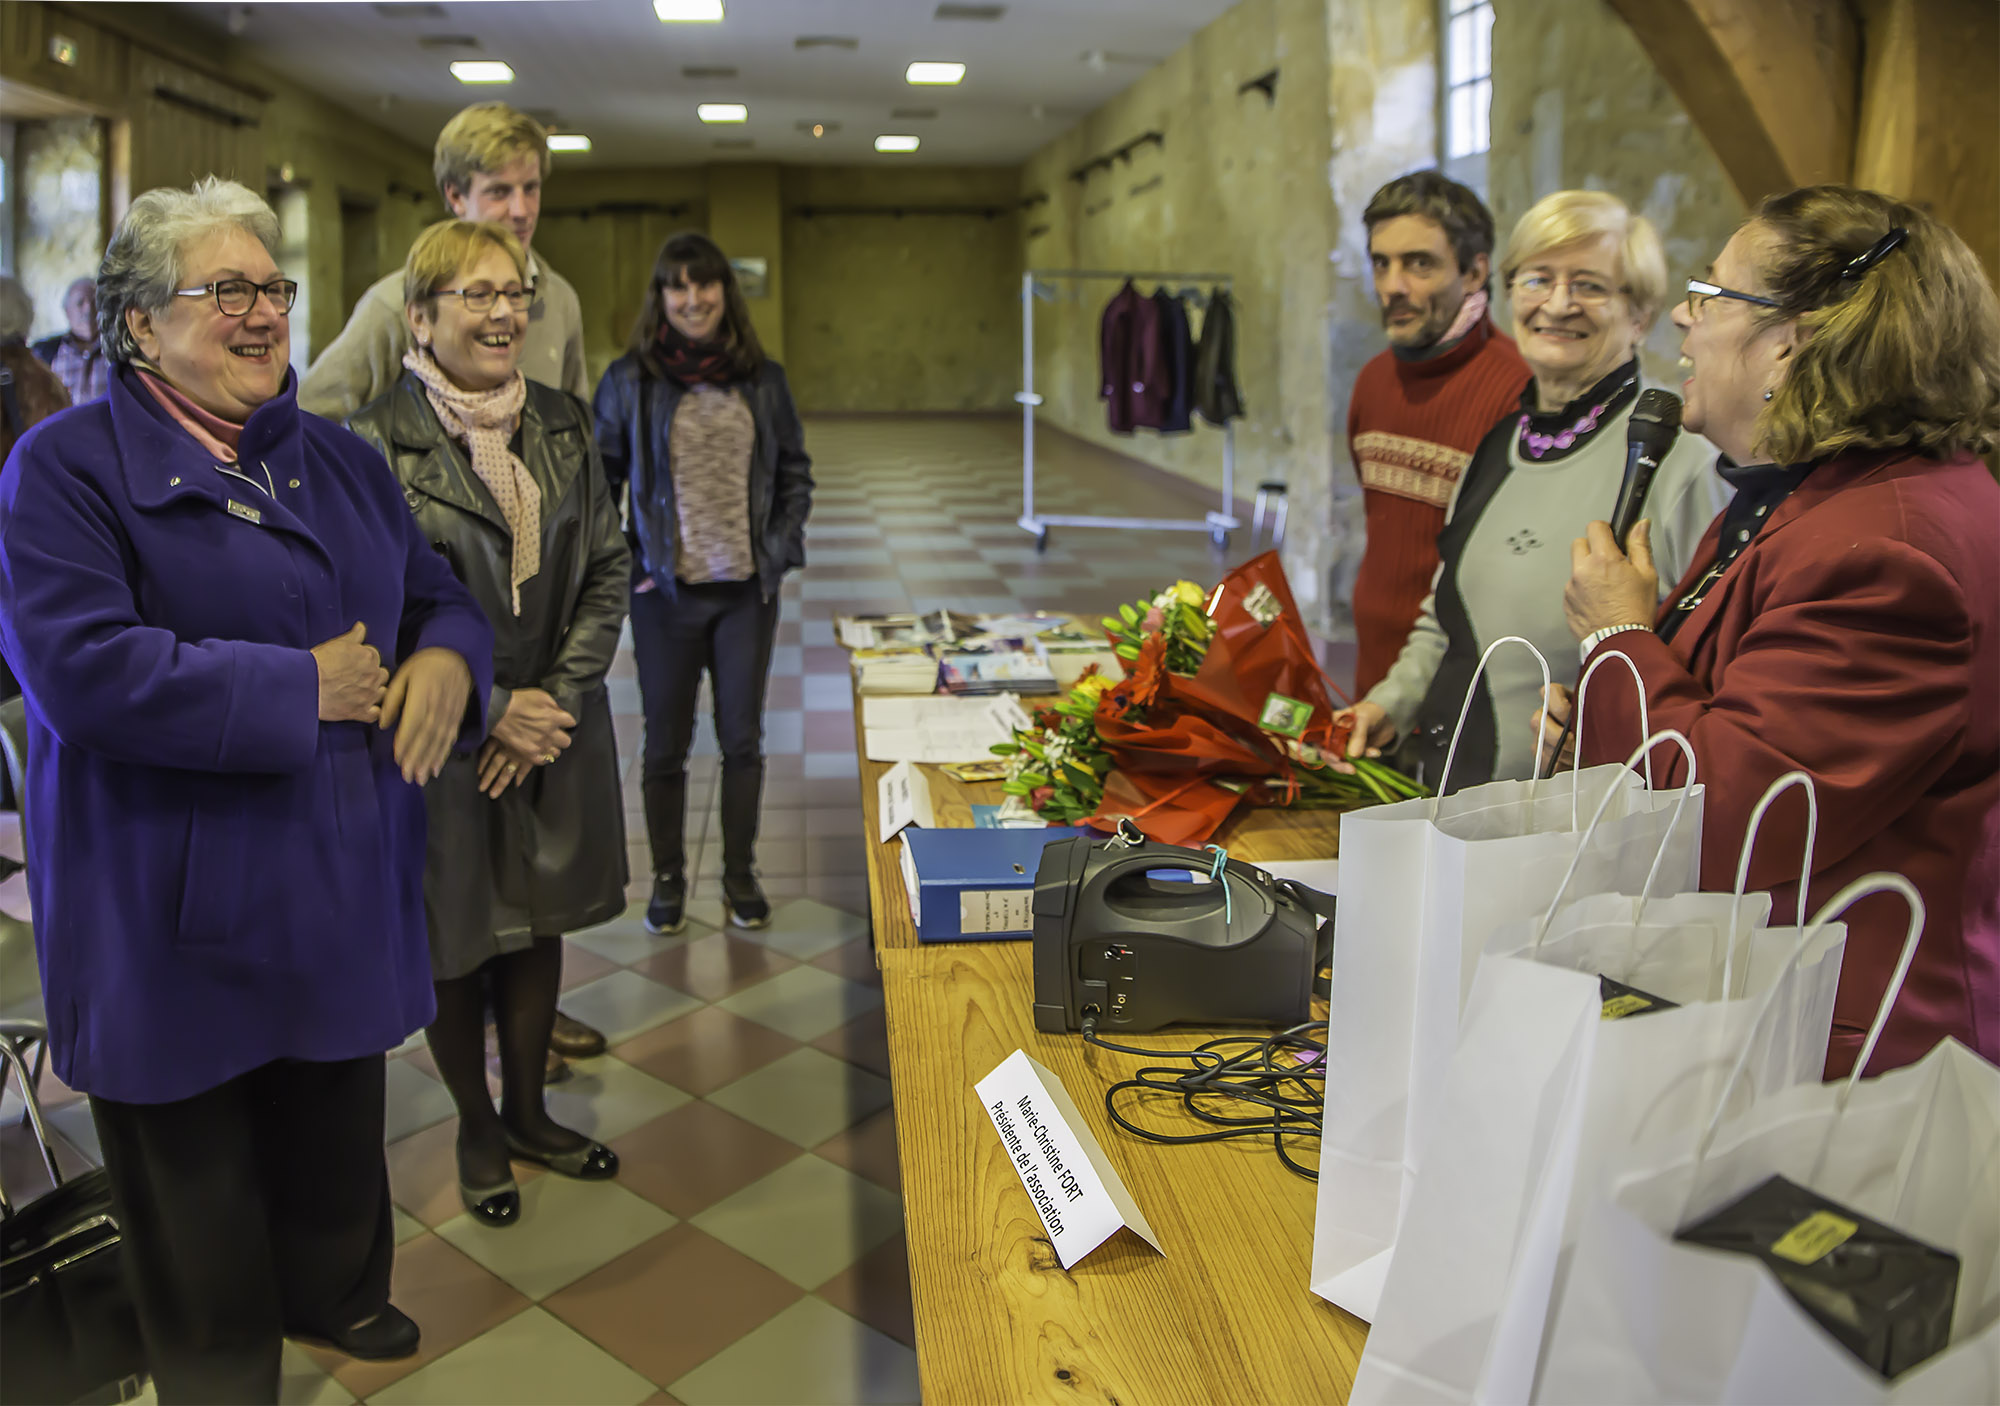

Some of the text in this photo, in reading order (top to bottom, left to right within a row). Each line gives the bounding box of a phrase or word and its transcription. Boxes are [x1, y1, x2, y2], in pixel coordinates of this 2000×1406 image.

[990, 1100, 1065, 1237] Présidente de l'association
[1016, 1094, 1084, 1203] Marie-Christine FORT
